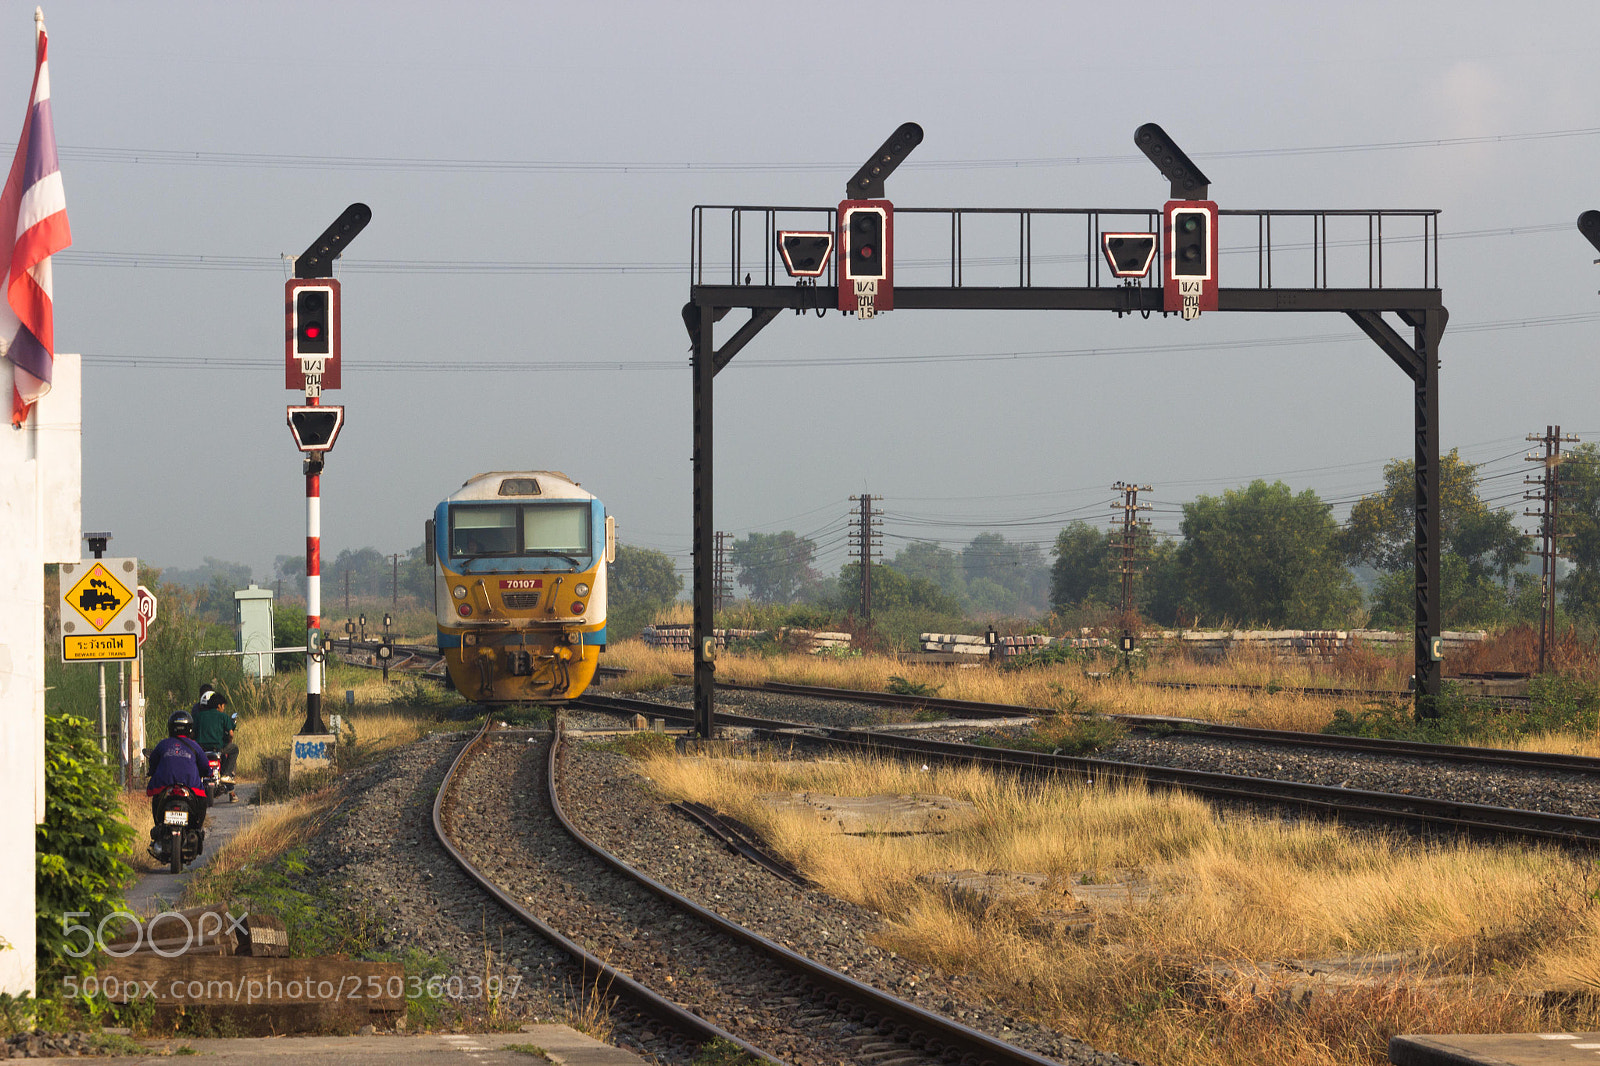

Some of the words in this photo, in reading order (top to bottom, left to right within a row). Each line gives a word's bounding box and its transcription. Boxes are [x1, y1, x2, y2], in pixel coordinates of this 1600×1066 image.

[860, 307, 873, 318] 15
[1185, 307, 1198, 318] 17
[307, 385, 320, 397] 31
[507, 580, 535, 589] 70107
[77, 638, 124, 650] ระวังรถไฟ
